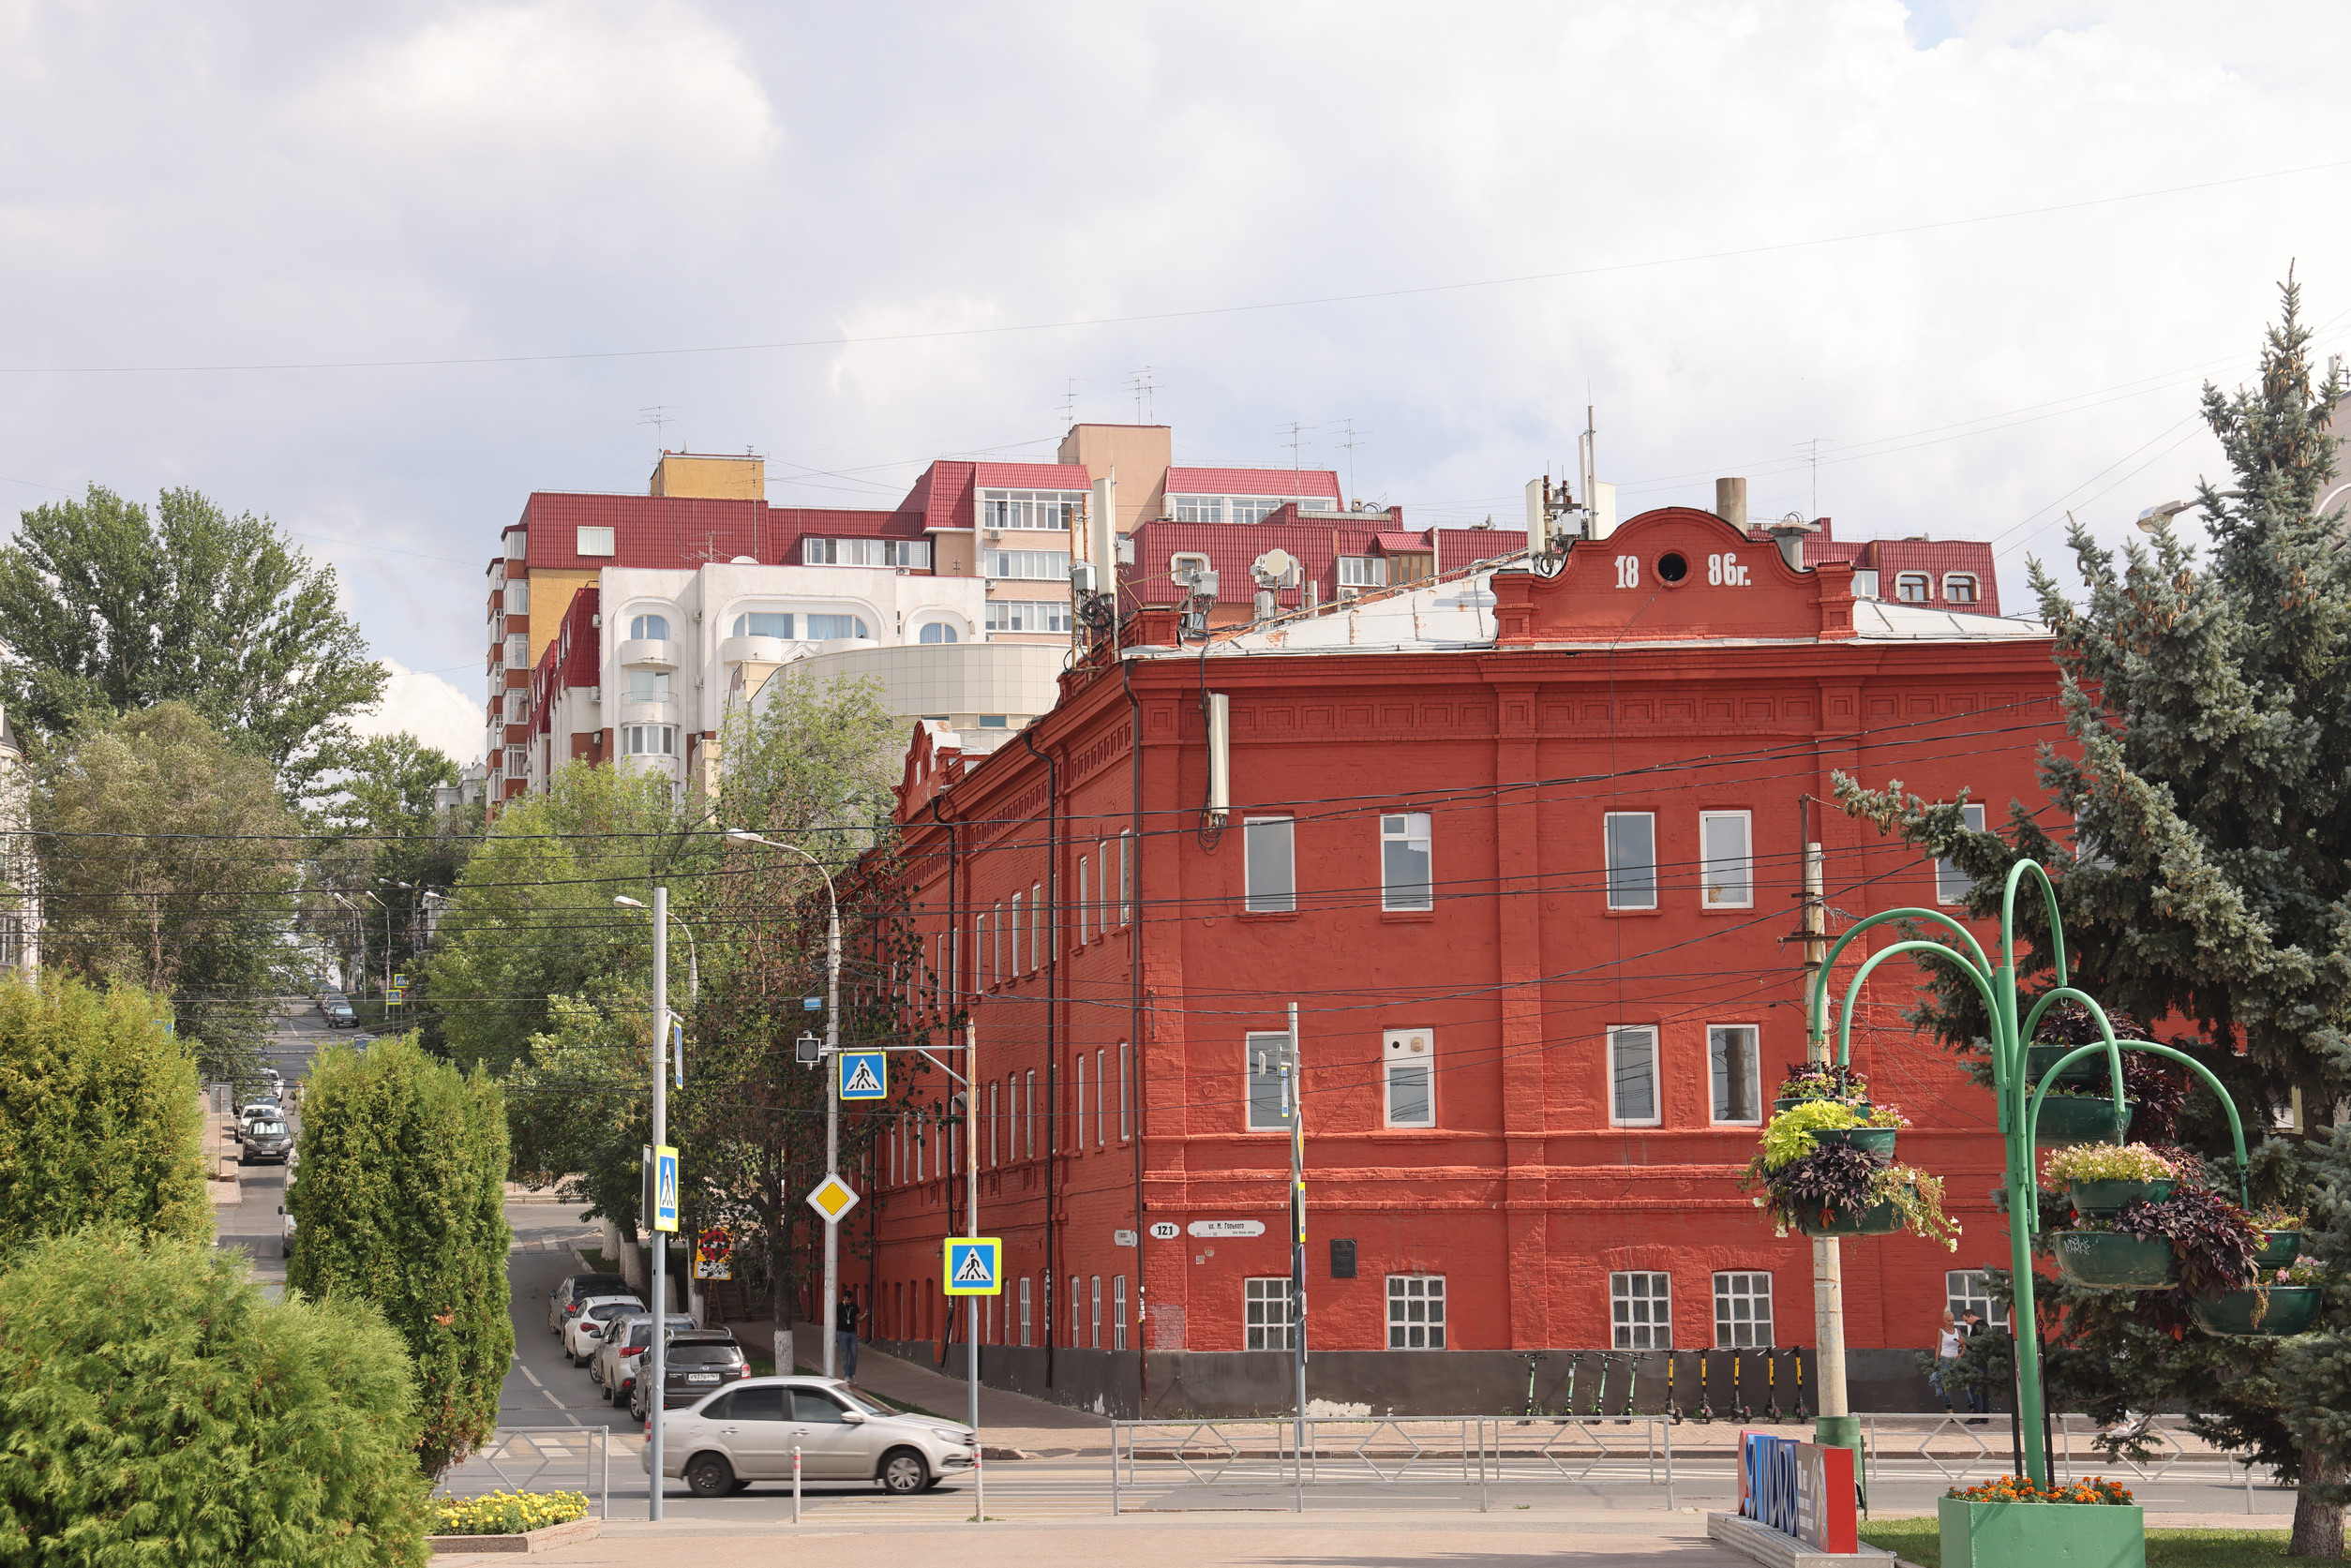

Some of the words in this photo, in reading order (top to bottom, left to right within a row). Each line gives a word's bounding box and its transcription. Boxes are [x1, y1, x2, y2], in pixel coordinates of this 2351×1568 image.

[1614, 555, 1640, 589] 18
[1708, 552, 1752, 587] 86г.
[1157, 1225, 1174, 1236] 121
